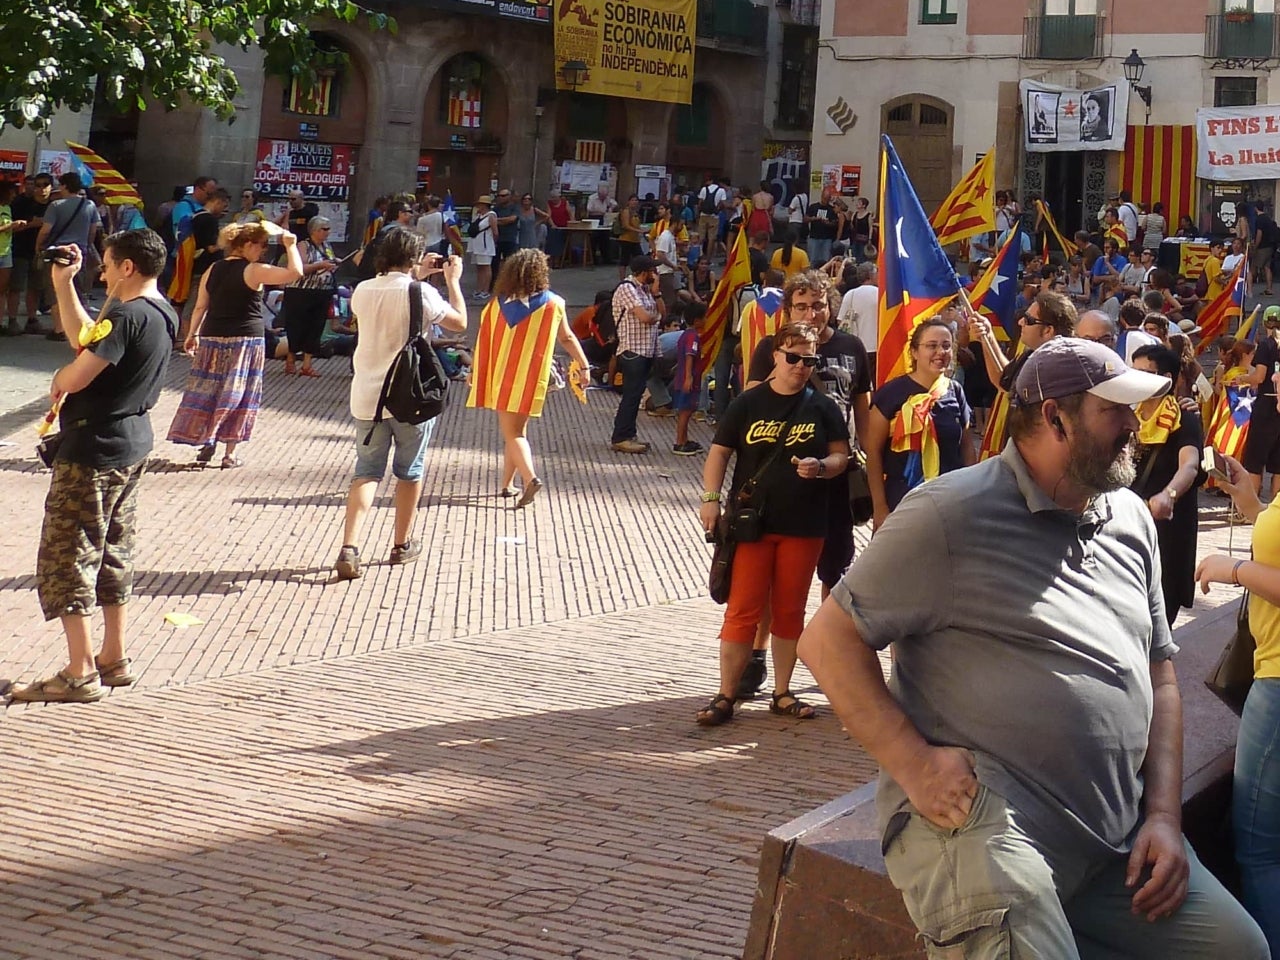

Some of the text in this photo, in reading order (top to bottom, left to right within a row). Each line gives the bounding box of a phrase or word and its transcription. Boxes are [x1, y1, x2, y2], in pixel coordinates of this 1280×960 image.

[499, 2, 535, 16] endavant
[604, 2, 686, 33] SOBIRANIA
[603, 23, 692, 55] ECONÒMICA
[602, 44, 636, 57] no hi ha
[601, 53, 688, 79] INDEPENDÈNCIA
[1207, 117, 1260, 136] FINS
[290, 143, 332, 155] BUSQUETS
[290, 154, 332, 166] GALVEZ
[1208, 150, 1234, 166] La
[254, 170, 286, 181] LOCAL
[253, 182, 272, 193] 93
[308, 185, 324, 195] 71
[329, 186, 344, 196] 71
[746, 420, 816, 446] Catalnya
